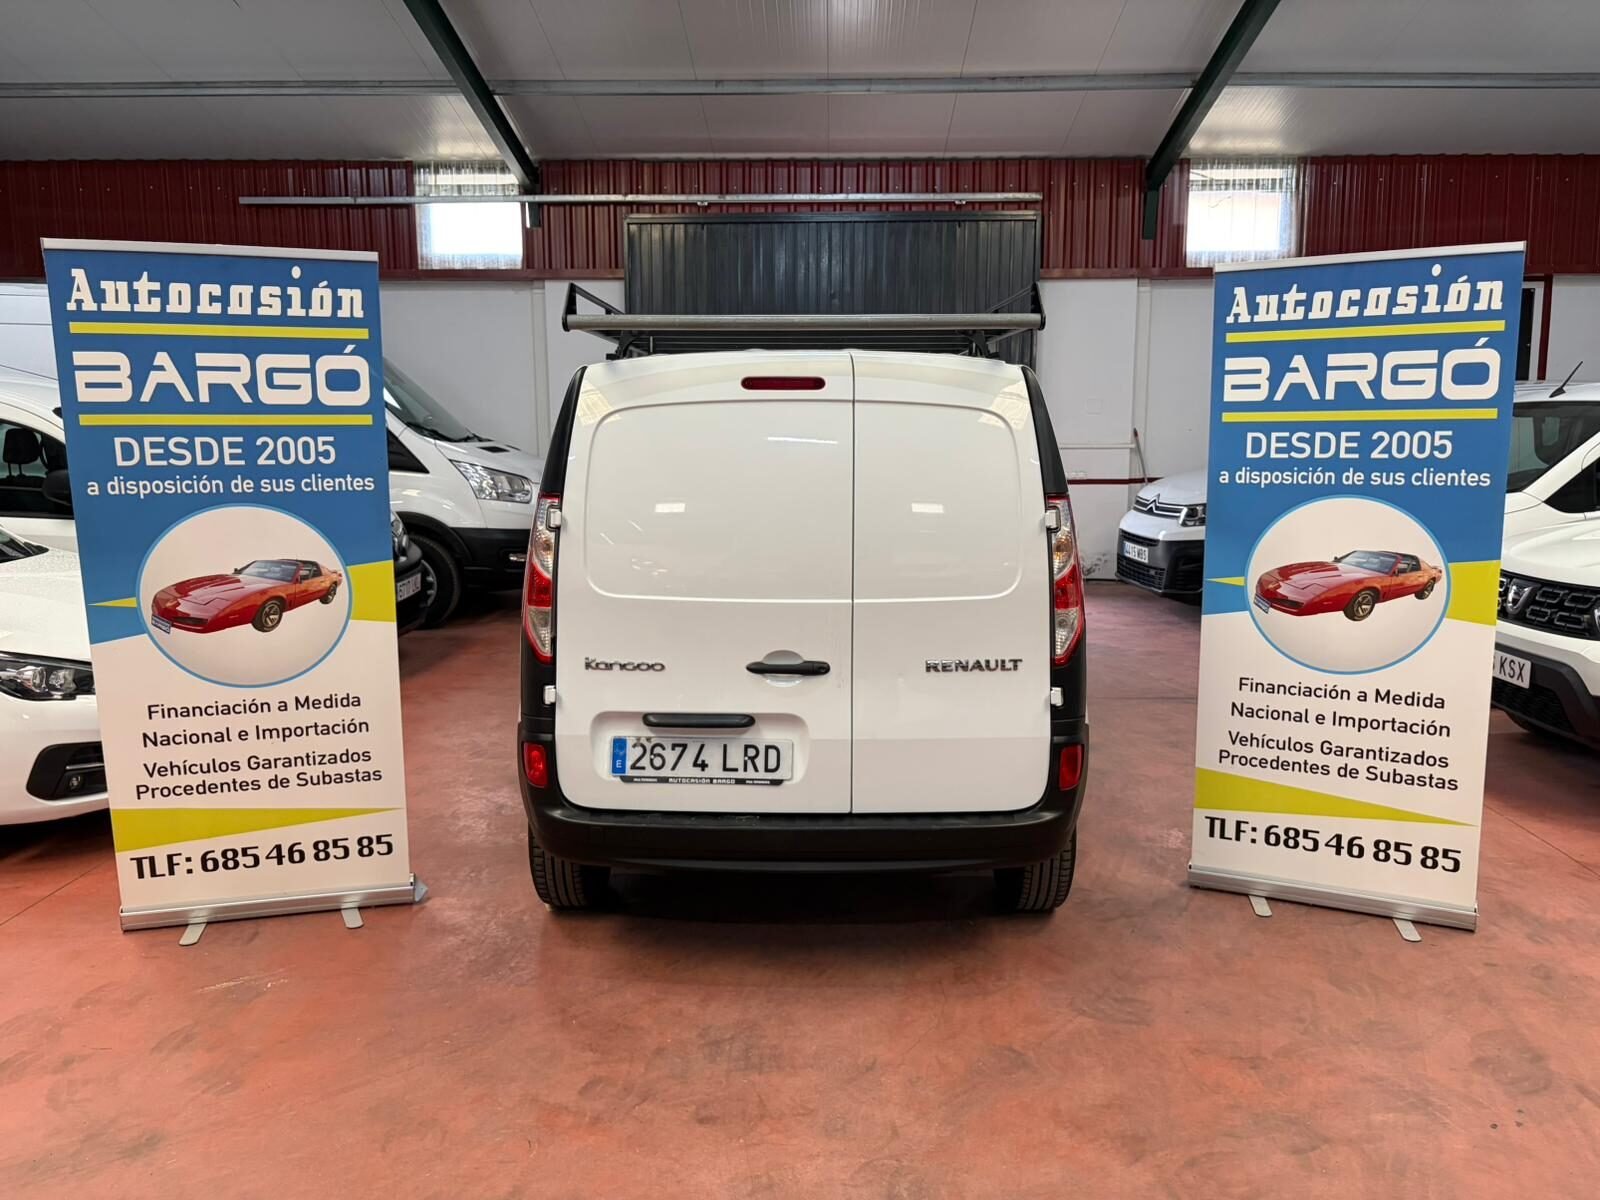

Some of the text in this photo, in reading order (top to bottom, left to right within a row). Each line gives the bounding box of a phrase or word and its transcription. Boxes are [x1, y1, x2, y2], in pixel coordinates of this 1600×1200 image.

[66, 265, 365, 319] Autocasión
[1226, 263, 1503, 325] Autocasión
[72, 344, 371, 407] BARGÓ
[1223, 337, 1501, 402] BARGÓ
[114, 436, 336, 467] DESDE 2005
[1246, 430, 1453, 459] DESDE 2005
[87, 474, 375, 499] a disposición de sus clientes
[1219, 466, 1491, 488] a disposición de sus clientes
[925, 659, 1023, 673] RENAULT
[1499, 656, 1525, 683] KSX
[147, 693, 361, 720] Financiación a Medida
[1238, 677, 1446, 709] Financiación a Medida
[142, 718, 369, 748] Nacional e Importación
[1230, 702, 1451, 737] Nacional e Importación
[143, 749, 372, 778] Vehículos Garantizados
[615, 759, 622, 768] E
[630, 742, 782, 773] 2674 LRD
[1228, 730, 1449, 769] Vehículos Garantizados
[136, 768, 383, 800] Procedentes de Subastas
[1218, 750, 1459, 791] Procedentes de Subastas
[130, 834, 394, 879] TLF: 685 46 85 85
[1204, 816, 1462, 873] TLF: 685 46 85 85
